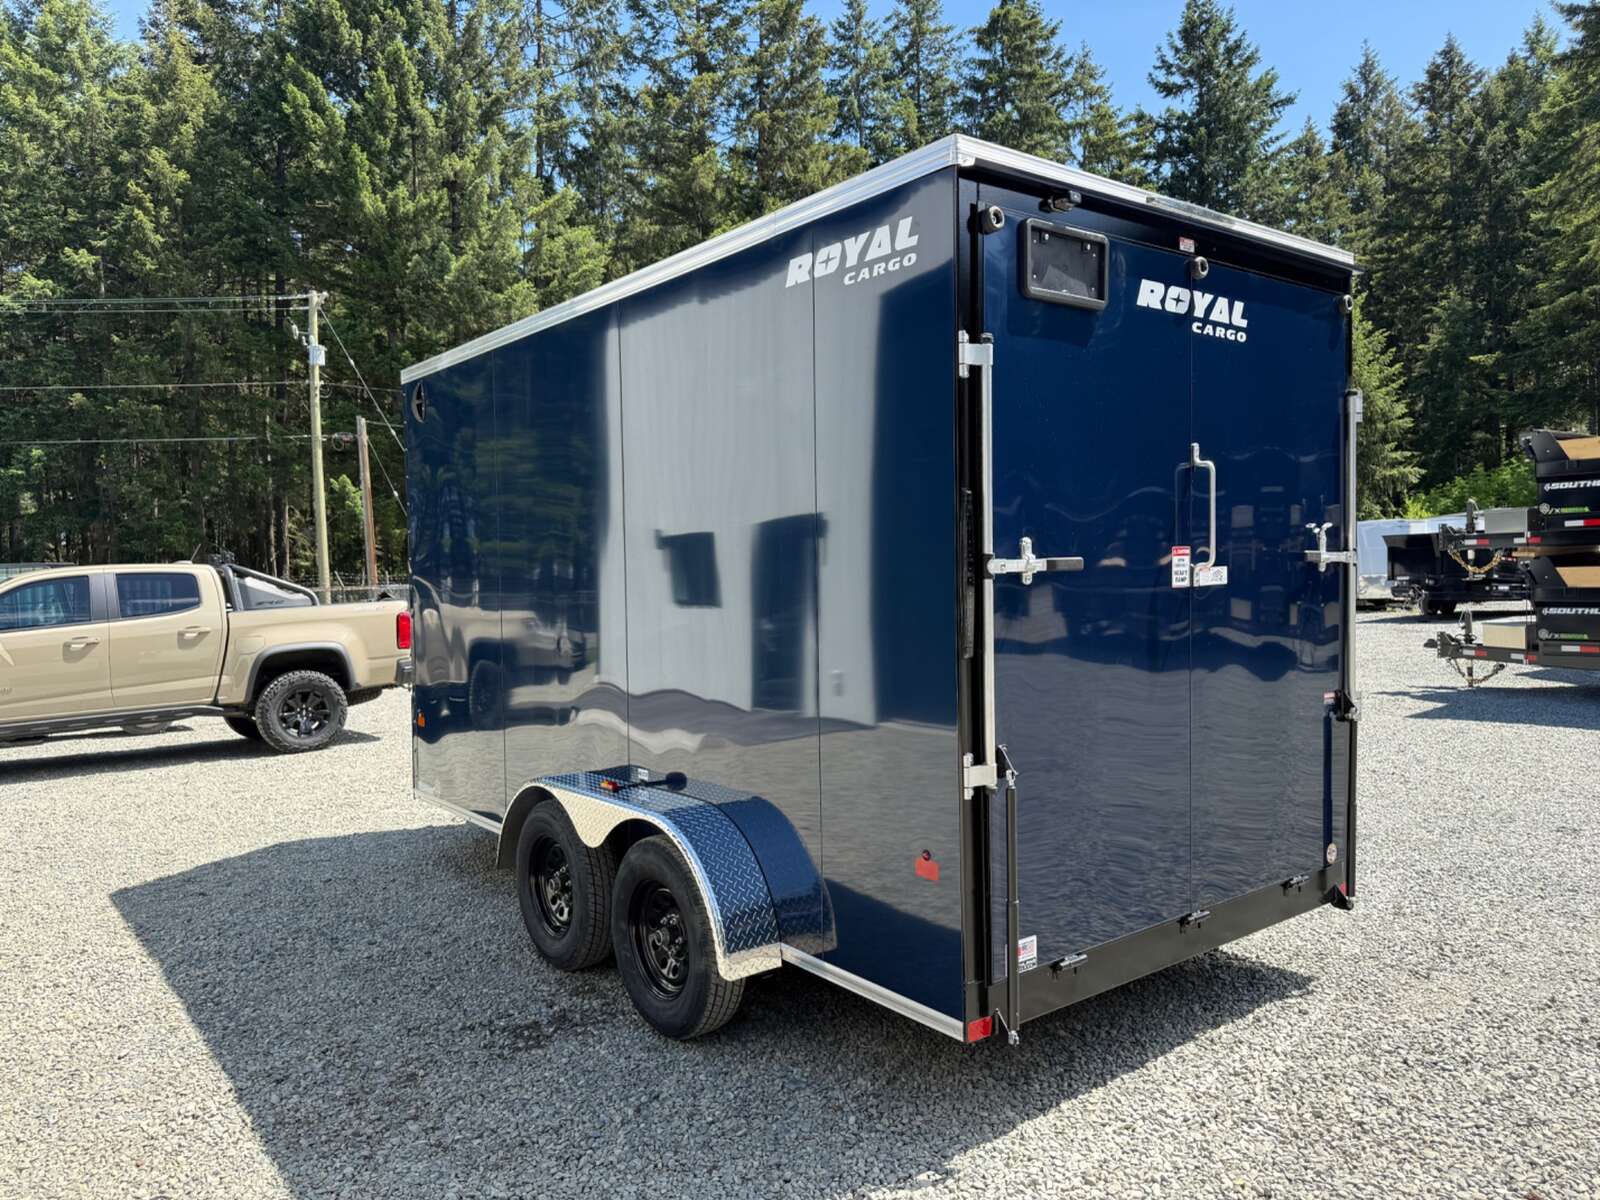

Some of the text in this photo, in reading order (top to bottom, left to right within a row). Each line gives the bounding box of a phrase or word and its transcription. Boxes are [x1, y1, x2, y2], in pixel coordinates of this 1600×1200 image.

[785, 216, 919, 288] ROYAL
[843, 252, 917, 286] CARGO
[1136, 278, 1248, 328] ROYAL
[1191, 322, 1247, 343] CARGO
